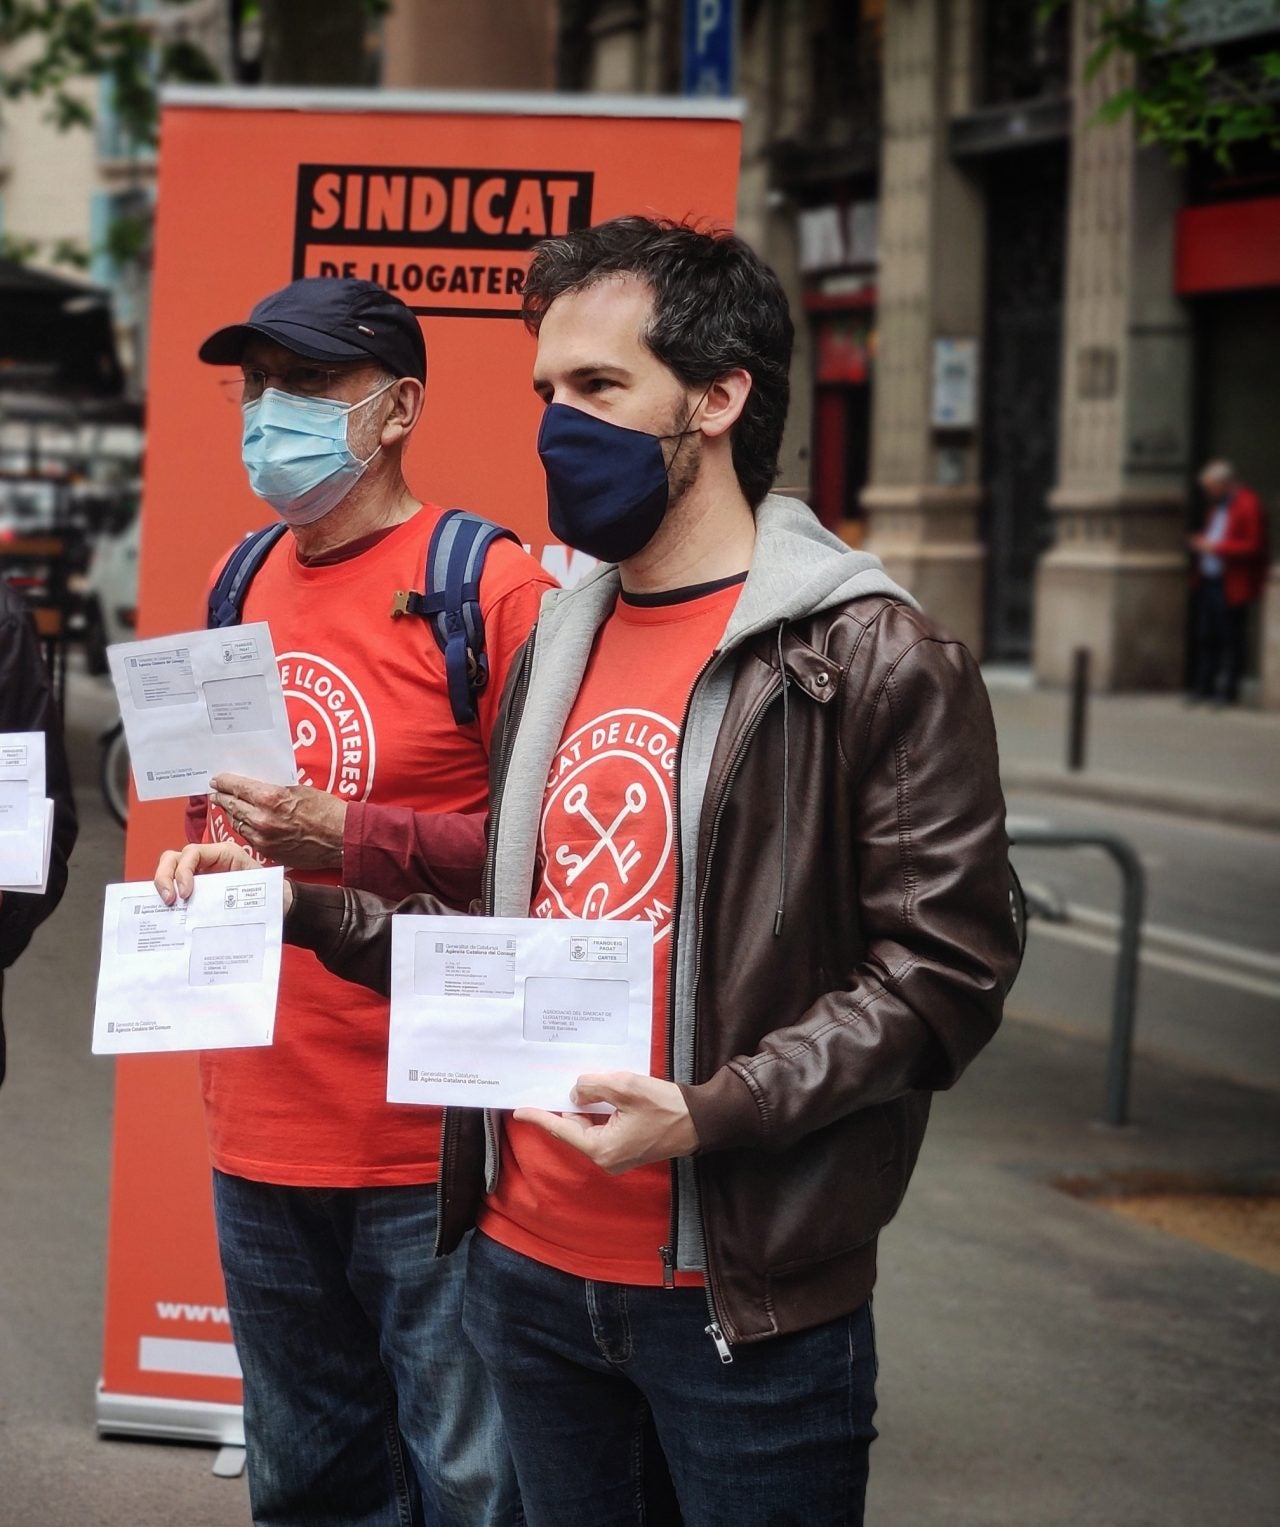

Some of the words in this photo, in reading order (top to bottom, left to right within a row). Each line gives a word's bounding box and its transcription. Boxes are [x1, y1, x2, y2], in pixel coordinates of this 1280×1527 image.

[311, 173, 579, 236] SINDICAT
[280, 665, 290, 686] E
[295, 665, 362, 796] LLOGATERES
[592, 722, 621, 749] DE
